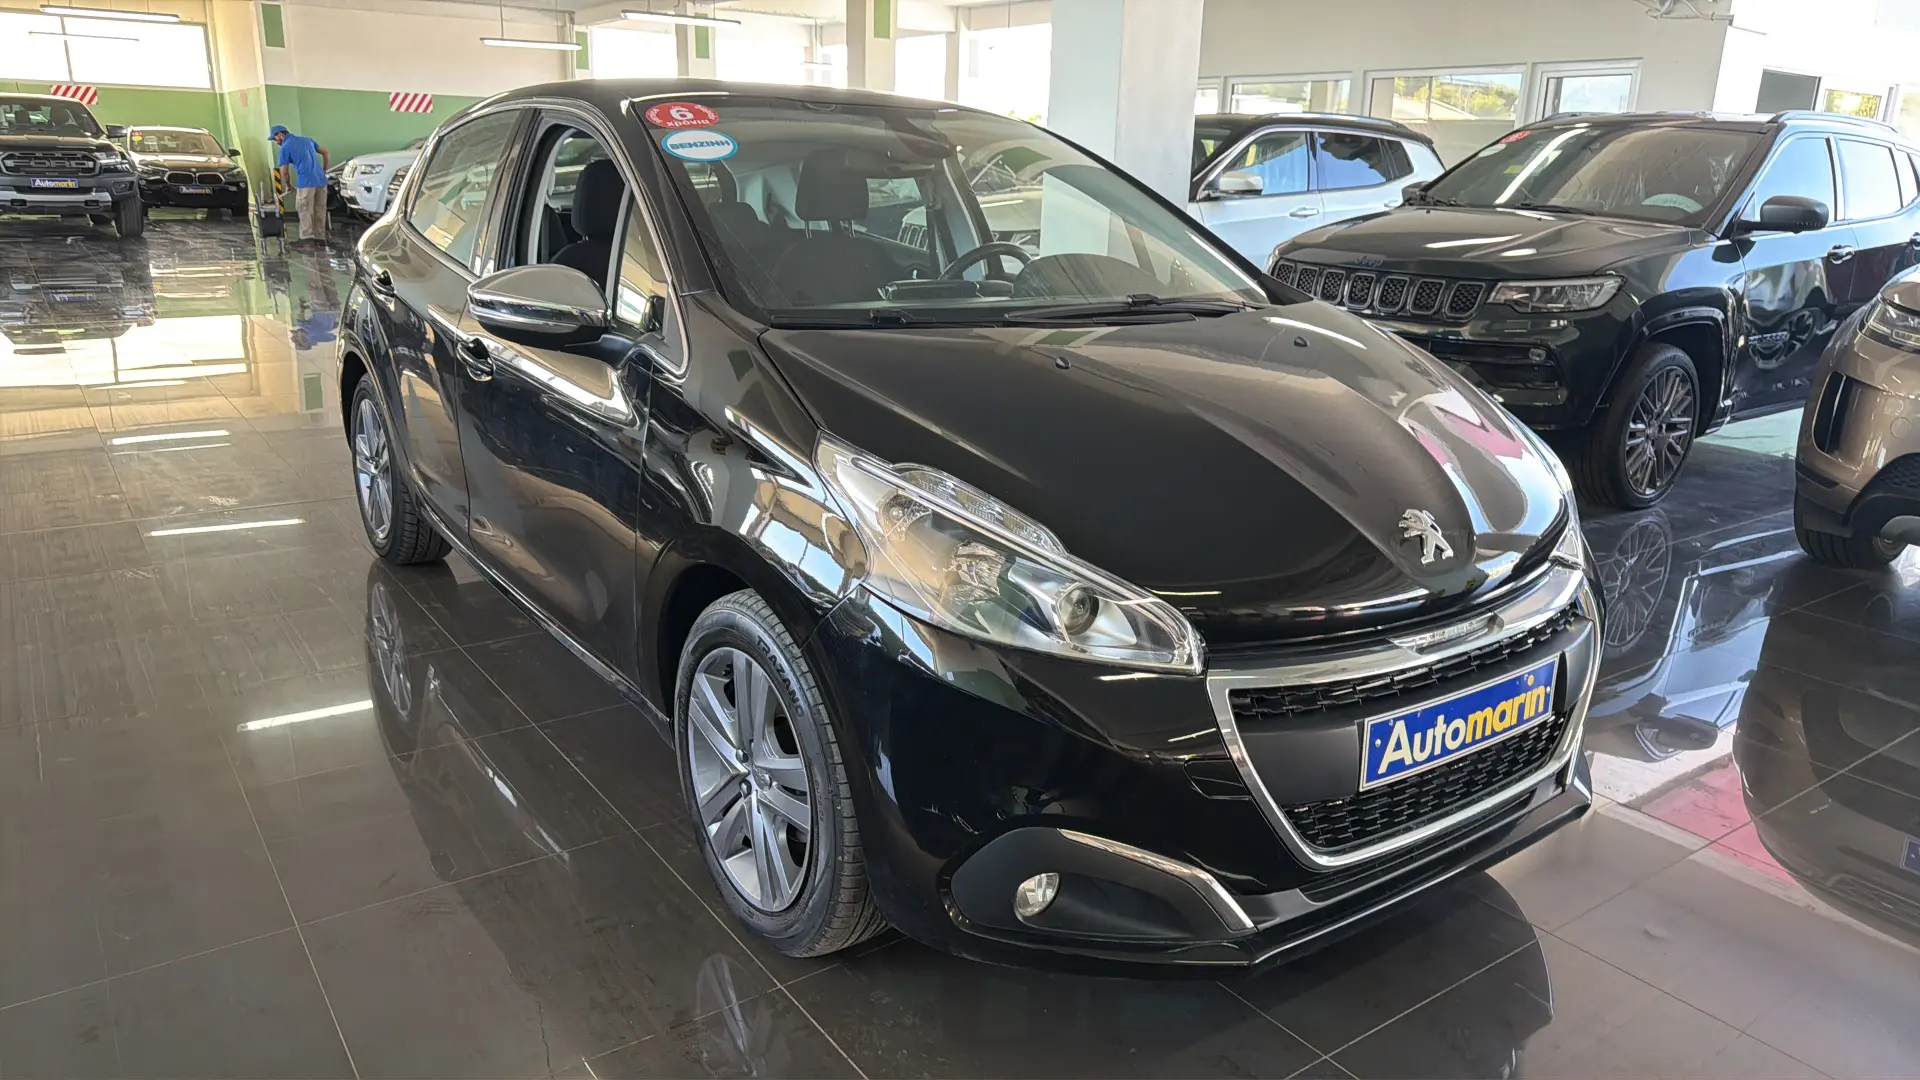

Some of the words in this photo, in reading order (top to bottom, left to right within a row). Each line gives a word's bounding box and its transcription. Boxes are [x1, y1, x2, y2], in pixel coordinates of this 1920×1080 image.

[666, 119, 711, 128] χρόνια
[669, 107, 694, 120] 6
[756, 634, 805, 718] TRAZANO
[1377, 674, 1547, 775] Automarin
